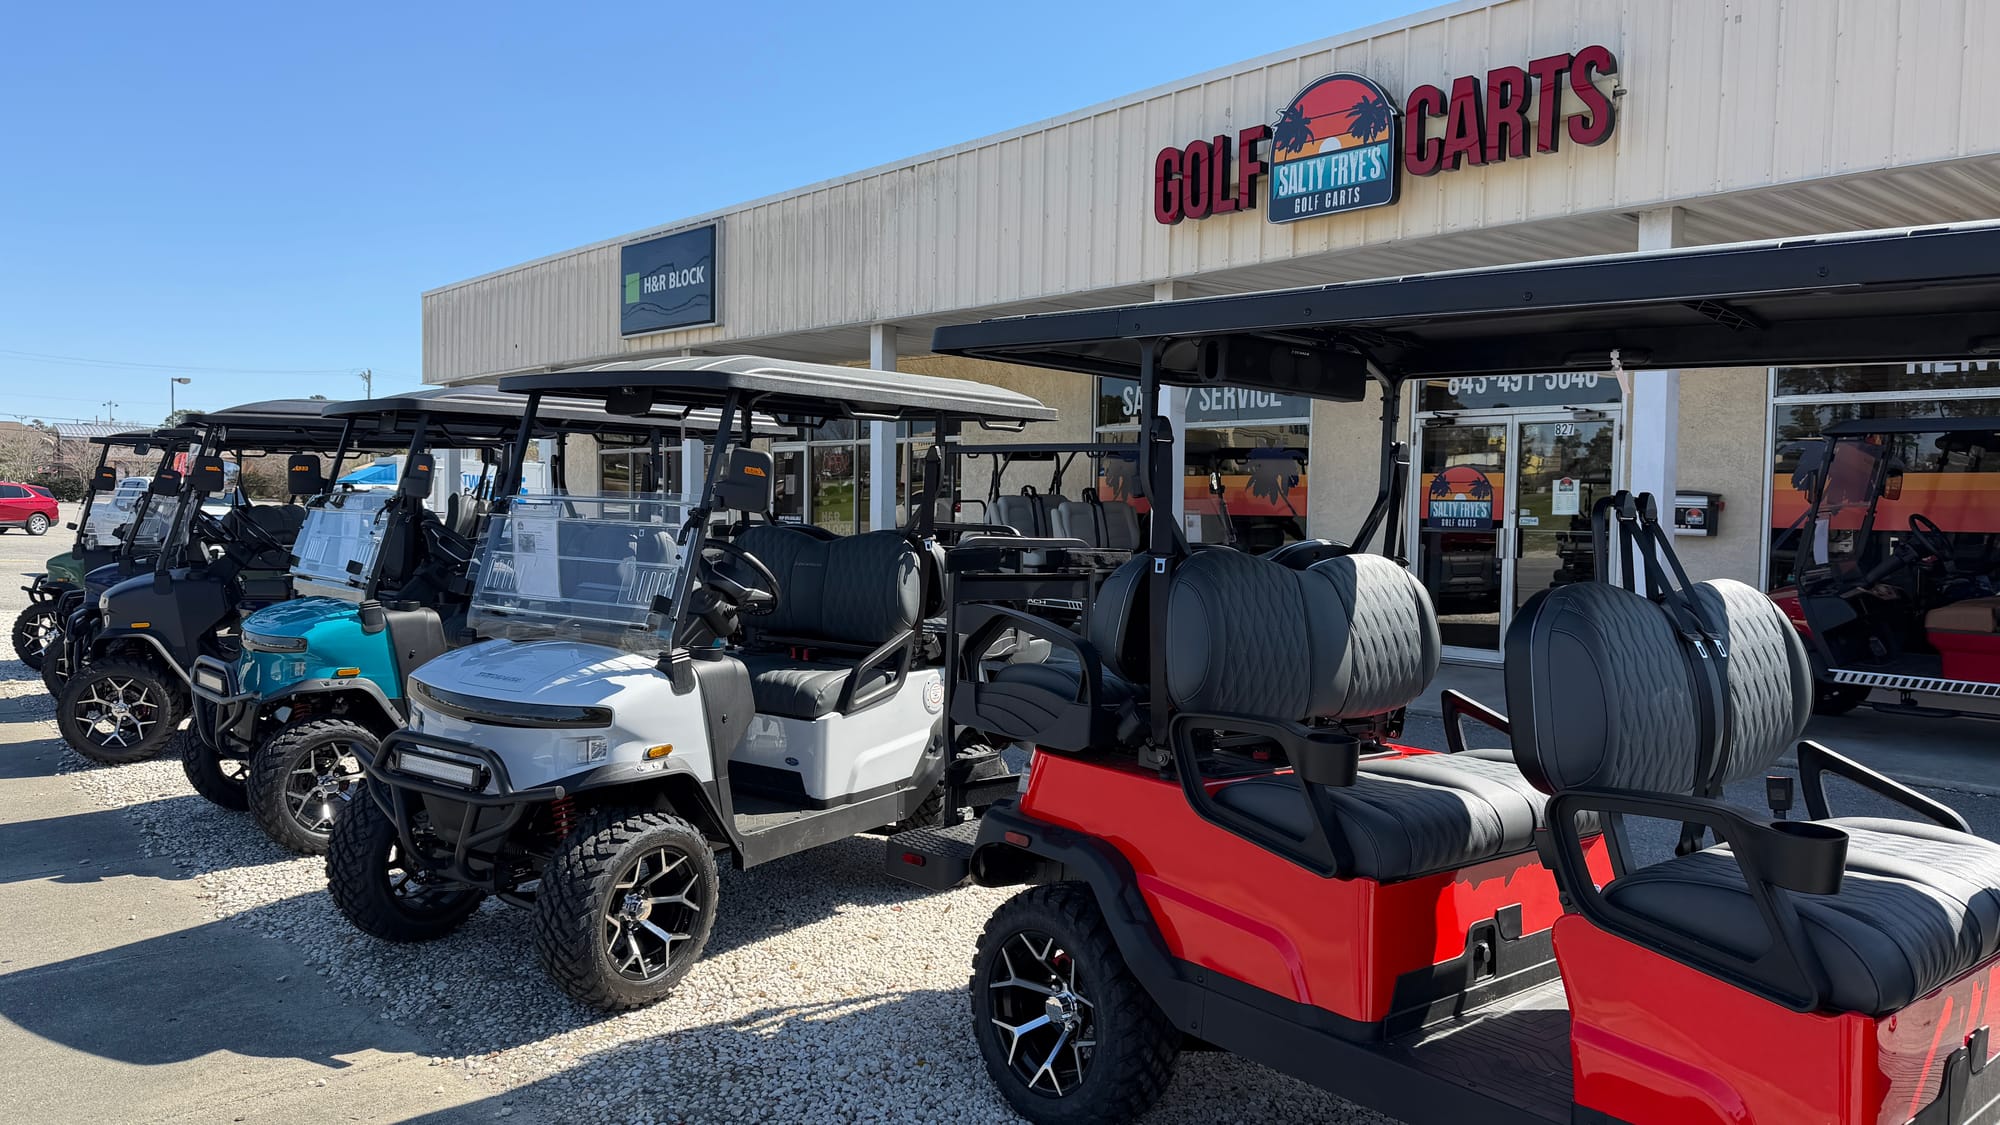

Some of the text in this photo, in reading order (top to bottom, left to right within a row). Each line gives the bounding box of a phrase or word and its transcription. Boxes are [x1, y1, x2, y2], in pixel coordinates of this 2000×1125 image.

[1154, 45, 1618, 225] GOLF CARTS
[1279, 145, 1381, 197] SALTY FRYE'S
[1294, 186, 1360, 214] GOLF CARTS
[643, 265, 705, 294] H&R BLOCK
[1199, 387, 1282, 412] SERVICE
[1555, 423, 1574, 435] 827
[1433, 501, 1488, 518] SALTY FRYE'S
[1441, 518, 1477, 528] GOLF CARTS
